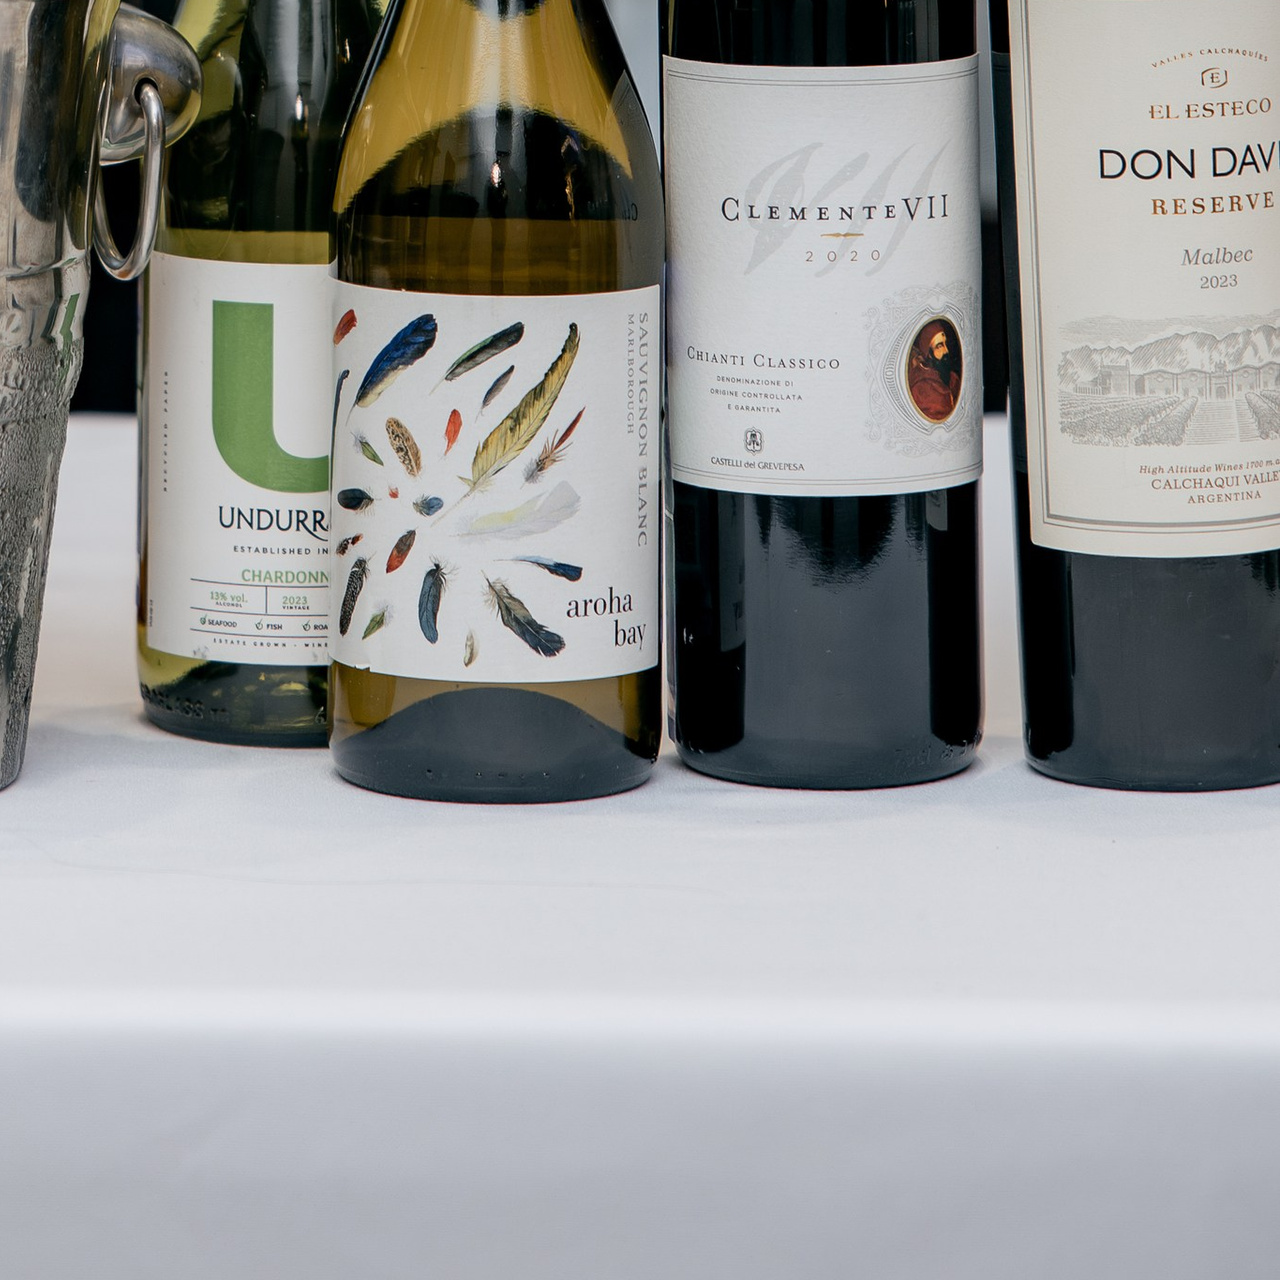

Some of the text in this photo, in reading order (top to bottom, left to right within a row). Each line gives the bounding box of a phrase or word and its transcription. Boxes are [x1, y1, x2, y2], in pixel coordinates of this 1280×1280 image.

[1151, 48, 1268, 68] VALLES CALCHAQUÍES
[1149, 97, 1272, 120] EL ESTECO
[1099, 148, 1196, 180] DON
[1151, 191, 1275, 216] RESERVE
[805, 249, 881, 263] 2020
[1181, 247, 1253, 266] Malbec
[1200, 274, 1238, 289] 2023
[687, 346, 841, 370] CHIANTI CLASSICO
[627, 314, 635, 435] MARLBOROUGH
[716, 375, 781, 387] DENOMINAZIONE
[710, 388, 803, 401] ORIGINE CONTROLLATA
[734, 404, 781, 413] GARANTITA
[637, 312, 649, 547] SAUVIGNON BLANC
[711, 456, 743, 468] CASTELLI
[758, 461, 805, 471] GREVEPESA
[1139, 465, 1165, 475] High
[1167, 464, 1212, 474] Altitude
[1215, 462, 1243, 472] Wines
[1246, 460, 1263, 469] 1700
[1151, 475, 1240, 490] CALCHAQUI
[1187, 490, 1262, 504] ARGENTINA
[219, 505, 328, 541] UNDURR
[233, 545, 328, 555] ESTABLISHED IN
[210, 591, 248, 603] 13% vol.
[282, 595, 308, 605] 2023
[566, 586, 633, 618] aroha
[207, 619, 238, 628] SEAFOOD
[213, 637, 246, 646] ESTATE
[614, 619, 647, 650] bay
